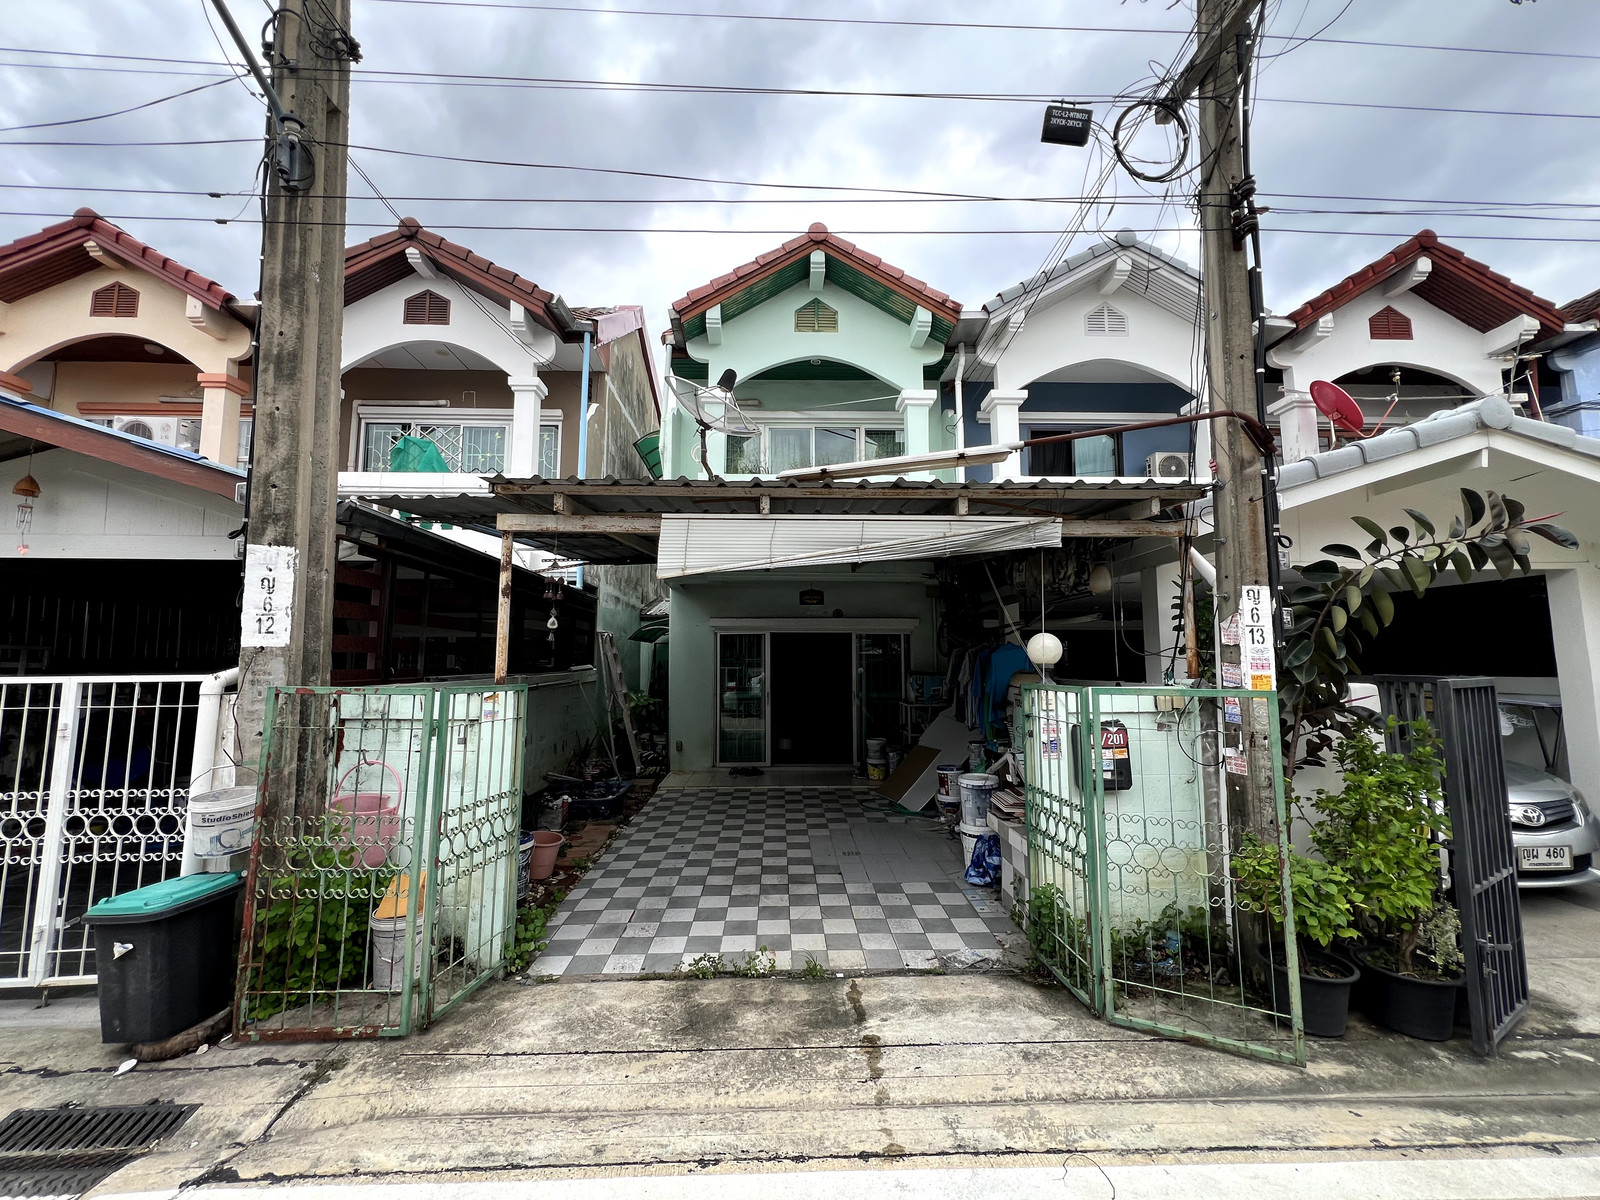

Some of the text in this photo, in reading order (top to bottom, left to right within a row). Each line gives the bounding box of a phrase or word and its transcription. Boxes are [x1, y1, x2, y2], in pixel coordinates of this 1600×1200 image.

[263, 596, 273, 613] 6
[1250, 606, 1260, 624] 6
[255, 616, 275, 635] 12
[1248, 627, 1266, 645] 13
[1546, 847, 1565, 859] 460
